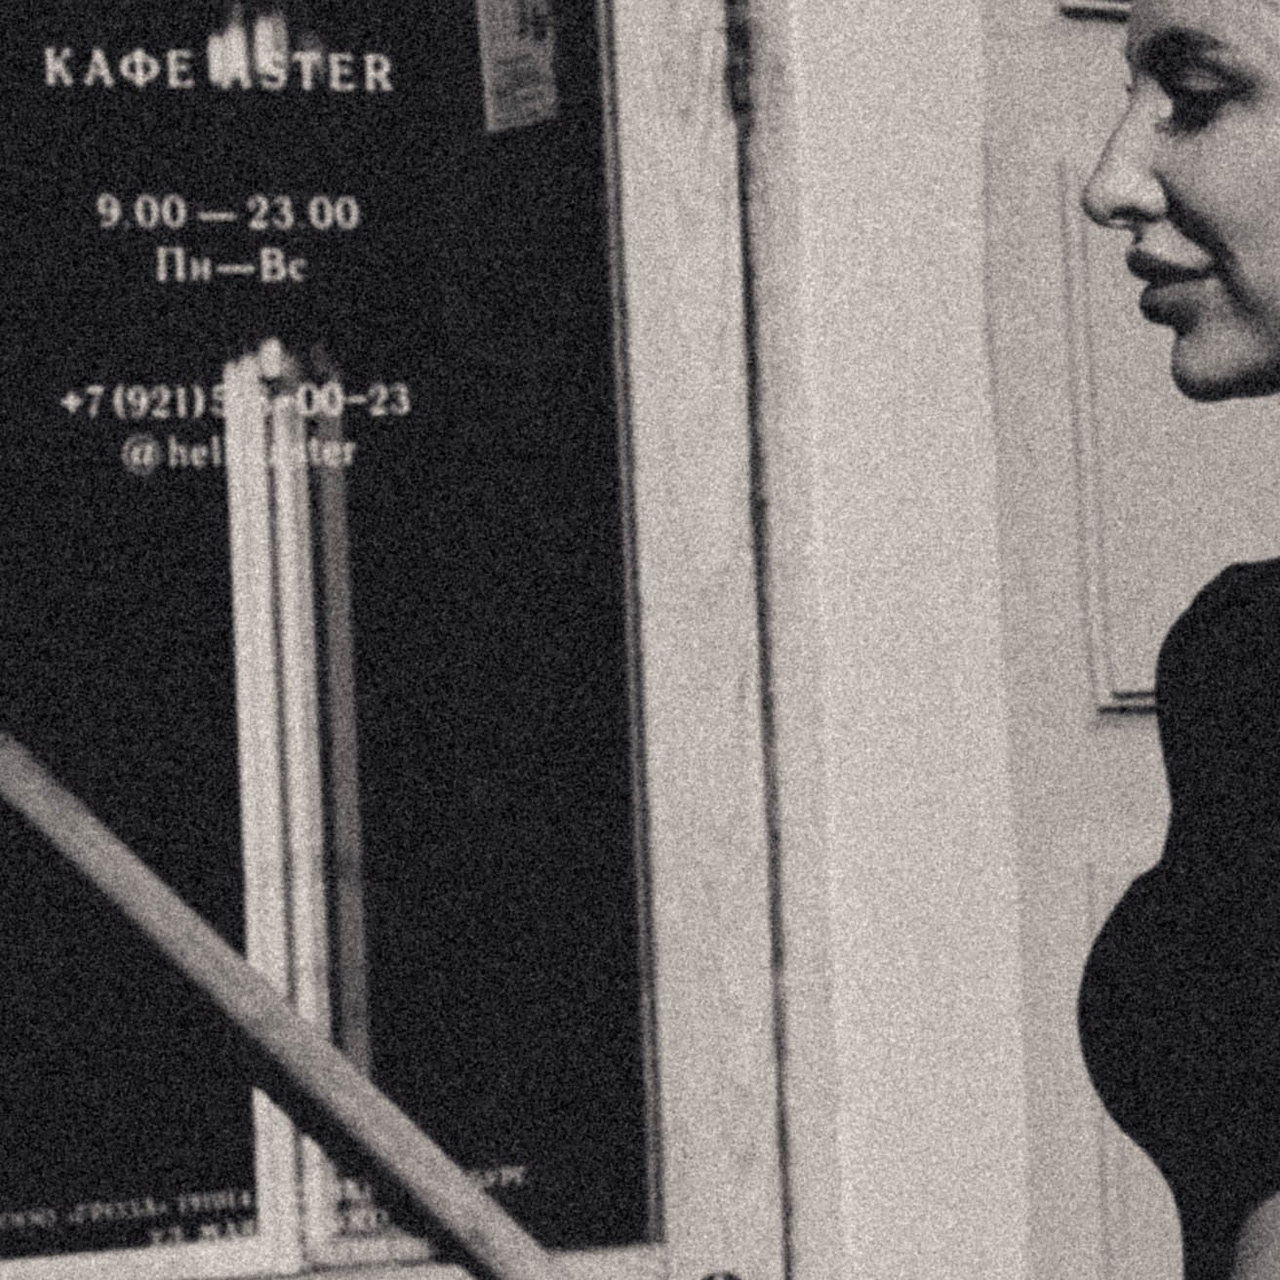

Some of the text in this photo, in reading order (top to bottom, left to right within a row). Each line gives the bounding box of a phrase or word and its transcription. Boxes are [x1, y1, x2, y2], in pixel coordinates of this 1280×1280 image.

[44, 47, 196, 89] КАФЕ
[96, 193, 188, 230] 9.00
[246, 194, 361, 230] 23.00
